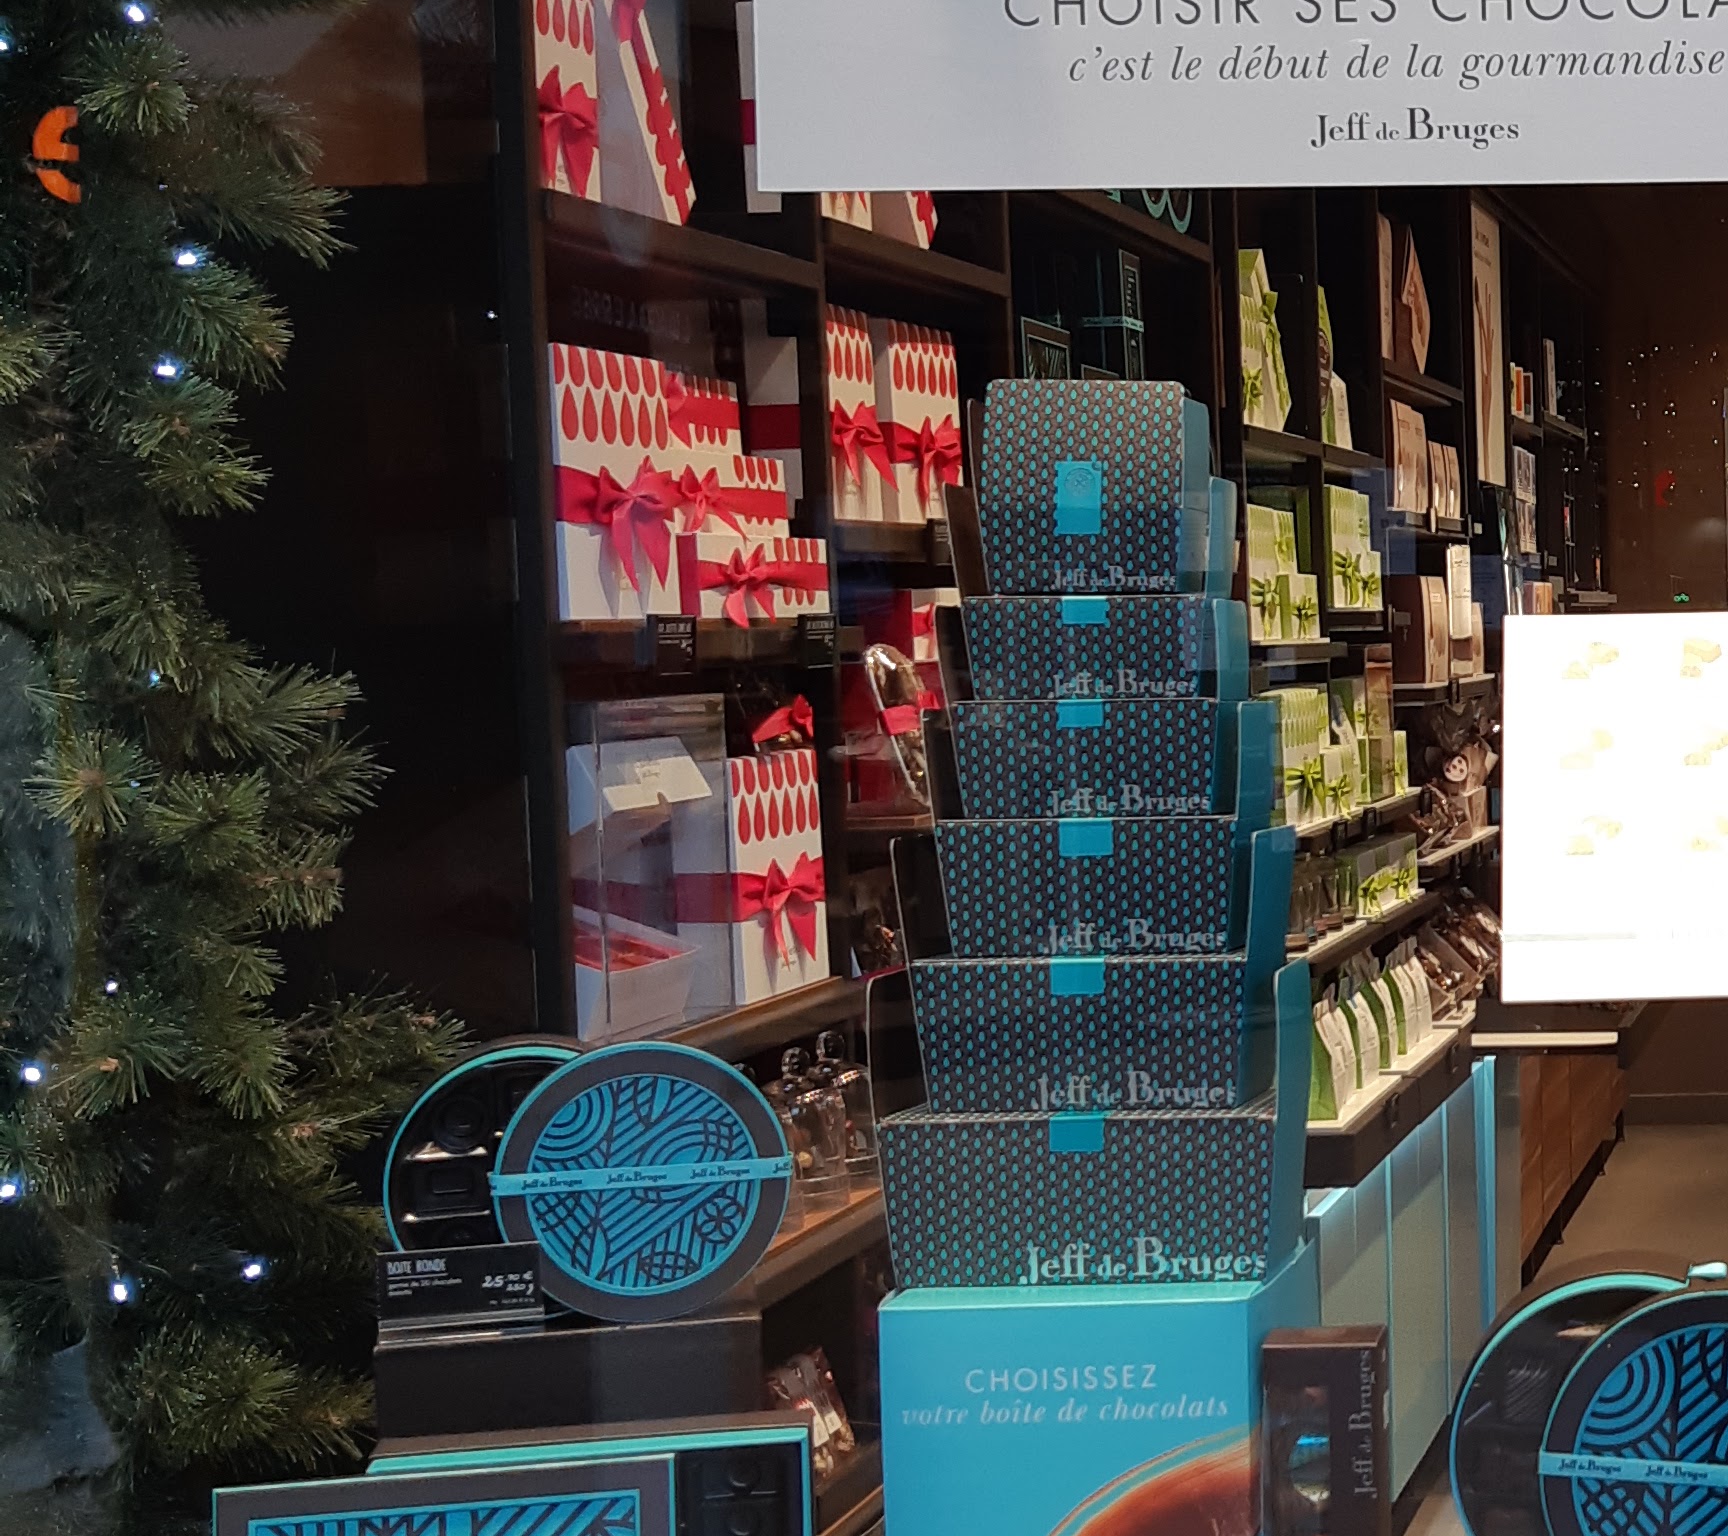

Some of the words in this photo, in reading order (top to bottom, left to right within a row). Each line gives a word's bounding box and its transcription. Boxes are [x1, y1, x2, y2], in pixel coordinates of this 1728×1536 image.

[1069, 46, 1154, 82] c'est
[1171, 45, 1202, 81] le
[1219, 43, 1329, 82] début
[1346, 44, 1390, 81] de
[1406, 43, 1444, 80] la
[1459, 41, 1727, 91] gourmandise
[1310, 114, 1371, 151] Jeff
[1375, 121, 1401, 142] de
[1404, 107, 1521, 151] Bruges
[1050, 568, 1088, 590] Jeff
[1109, 565, 1177, 589] Bruges
[1047, 671, 1093, 699] Jeff
[1116, 669, 1198, 696] Bruges
[1046, 787, 1094, 817] Jeff
[1121, 784, 1212, 814] Bruges
[1043, 923, 1098, 954] Jeff
[1125, 918, 1228, 952] Bruges
[1031, 1074, 1092, 1111] Jeff
[1125, 1070, 1237, 1109] Bruges
[1019, 1243, 1091, 1284] Jeff
[1097, 1254, 1127, 1278] de
[1133, 1235, 1267, 1282] Bruges
[965, 1365, 1157, 1394] CHOISISSEZ
[1348, 1349, 1376, 1431] Bruges
[902, 1403, 968, 1425] votre
[980, 1398, 1046, 1425] boîte
[1058, 1397, 1088, 1422] de
[1100, 1393, 1228, 1422] chocolats
[1351, 1452, 1377, 1499] Jeff
